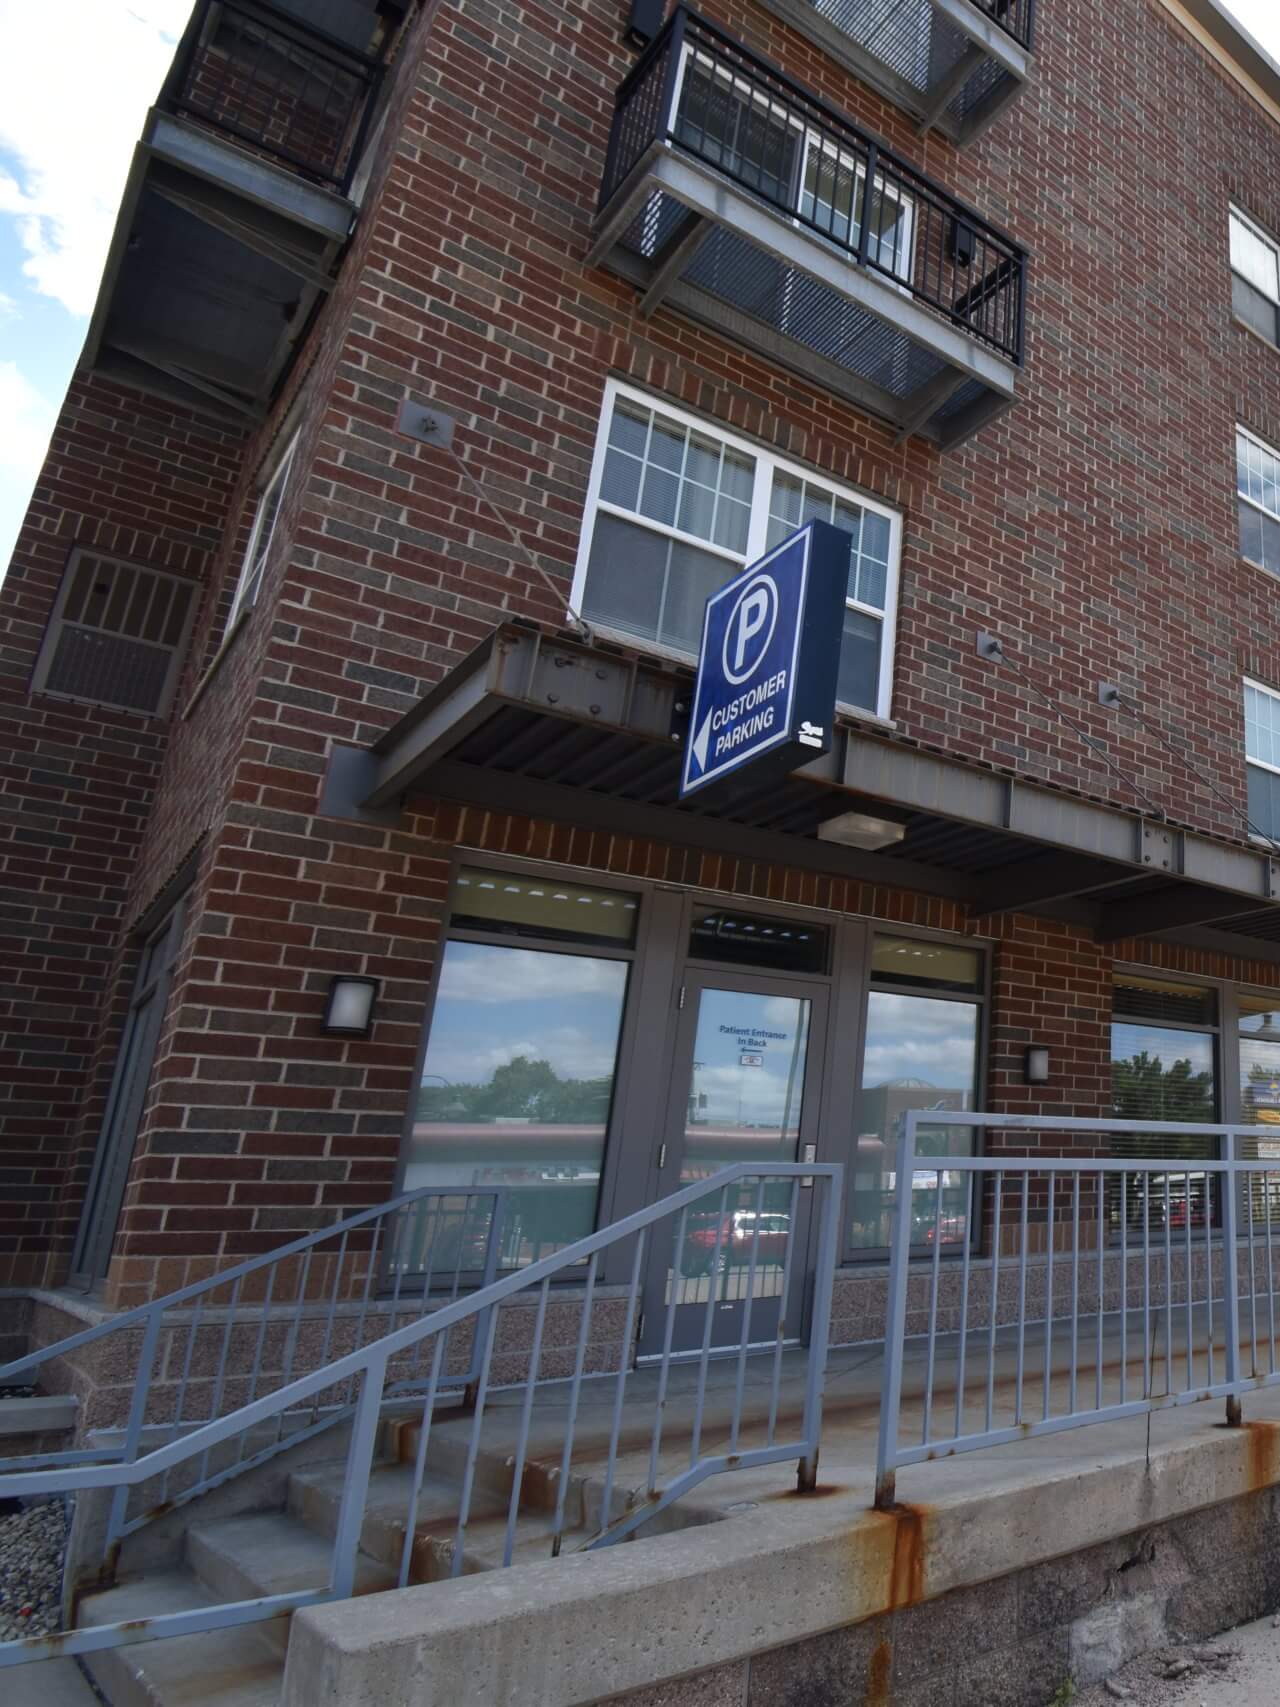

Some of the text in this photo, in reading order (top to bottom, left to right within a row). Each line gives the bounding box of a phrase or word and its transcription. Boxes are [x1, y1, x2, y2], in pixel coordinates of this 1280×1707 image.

[735, 588, 768, 670] P
[713, 670, 786, 730] CUSTOMER
[715, 706, 775, 757] PARKING
[719, 1025, 787, 1040] Patient Entrance
[748, 1038, 767, 1047] Back
